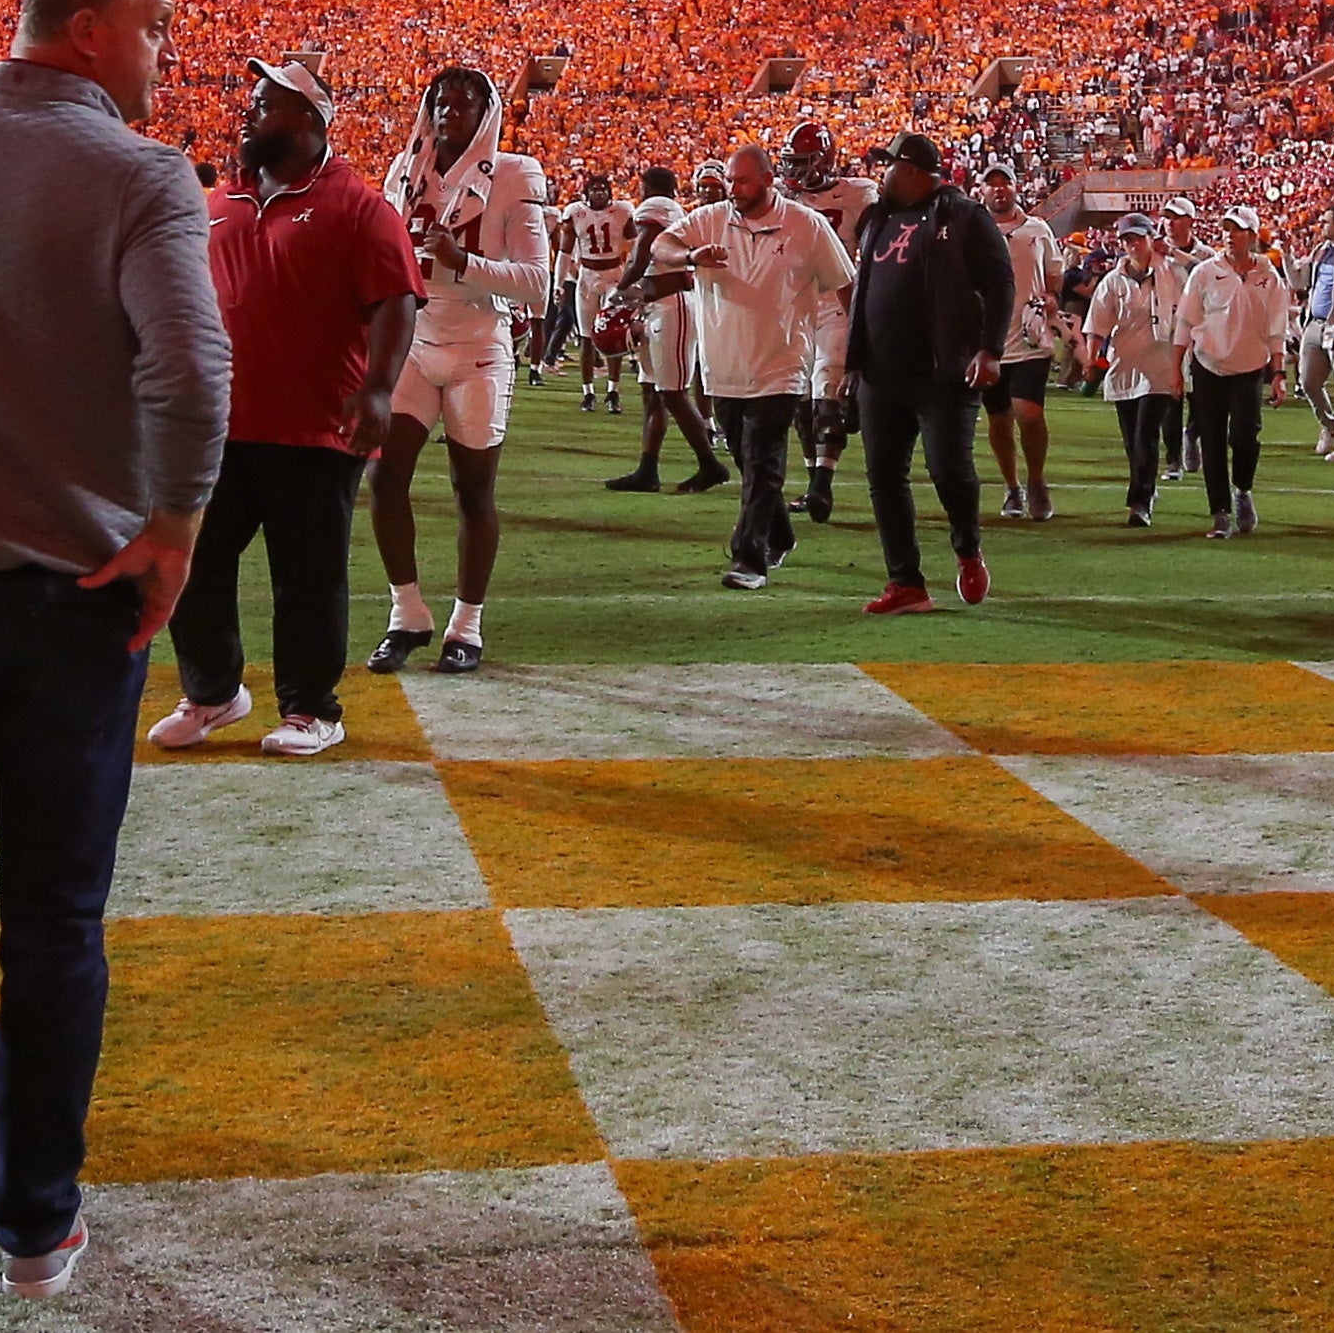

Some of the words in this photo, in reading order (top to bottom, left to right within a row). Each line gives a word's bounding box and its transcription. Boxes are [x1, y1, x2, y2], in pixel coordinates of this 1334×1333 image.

[292, 207, 315, 222] A
[586, 222, 612, 254] 11
[873, 223, 919, 264] A
[936, 226, 948, 240] A
